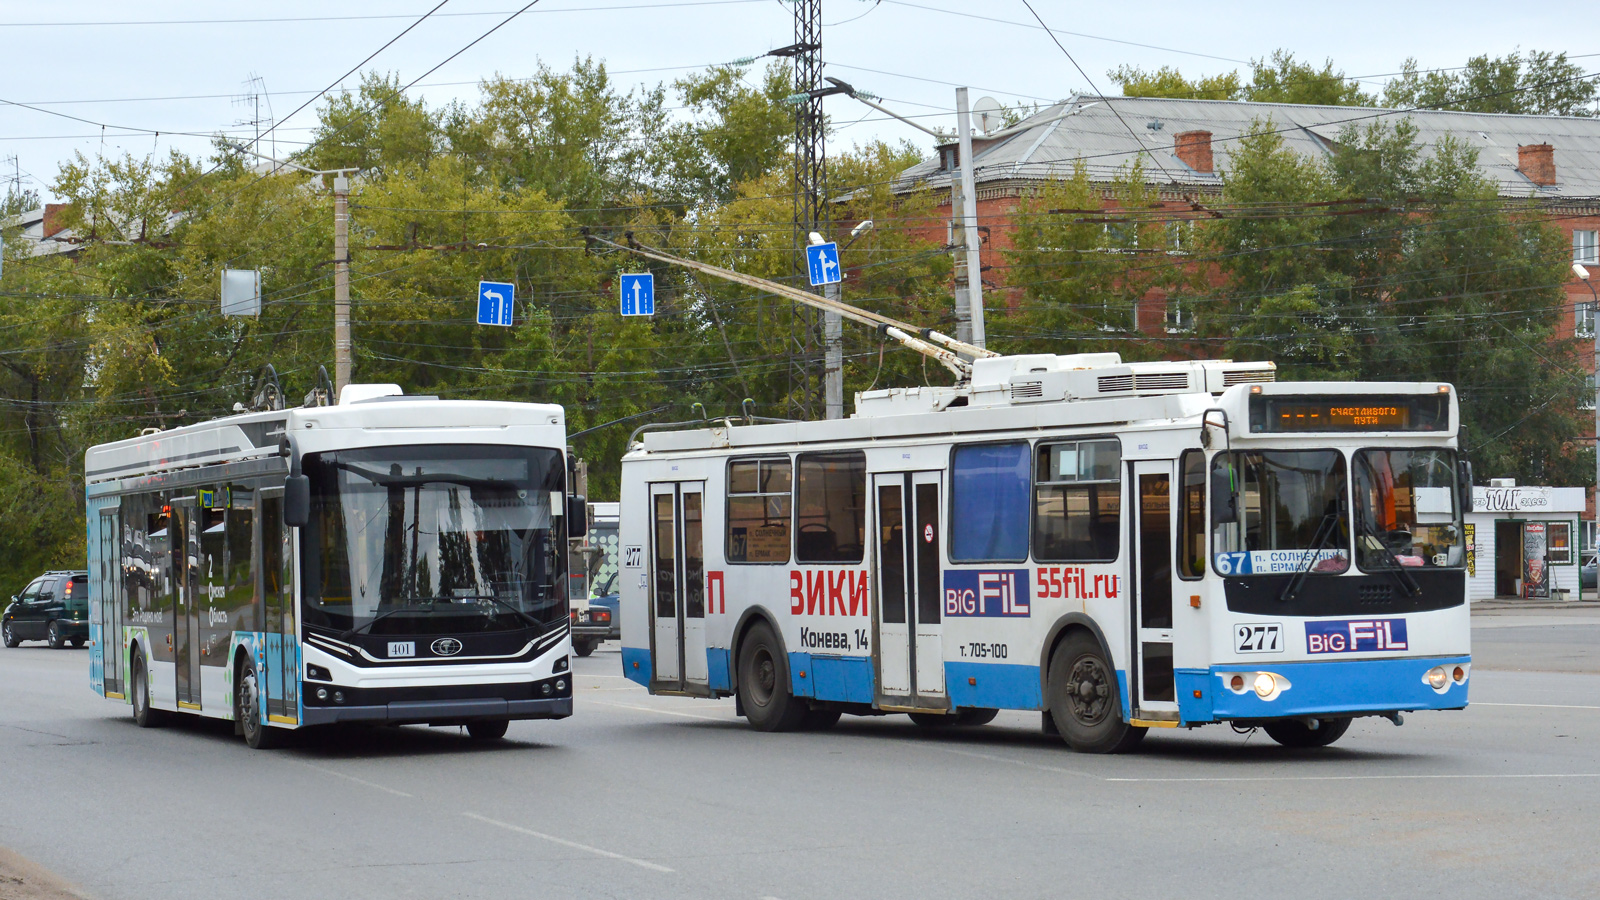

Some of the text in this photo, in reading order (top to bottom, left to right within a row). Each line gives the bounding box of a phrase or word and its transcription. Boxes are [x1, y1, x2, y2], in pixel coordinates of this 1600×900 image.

[1330, 407, 1397, 416] СЧАСТЛИВОГО
[1353, 416, 1378, 425] ПУТИ
[626, 547, 641, 566] 277
[1216, 552, 1247, 575] 67
[1270, 562, 1308, 572] ЕРМАК
[790, 570, 868, 617] ВИКИ
[946, 572, 1029, 615] BiG FiL
[1037, 567, 1118, 599] 55fil.ru
[800, 627, 868, 652] Конева, 14
[1239, 626, 1278, 650] 277
[1309, 621, 1407, 652] BiG FiL
[391, 643, 411, 656] 401
[969, 642, 1008, 658] 705-100
